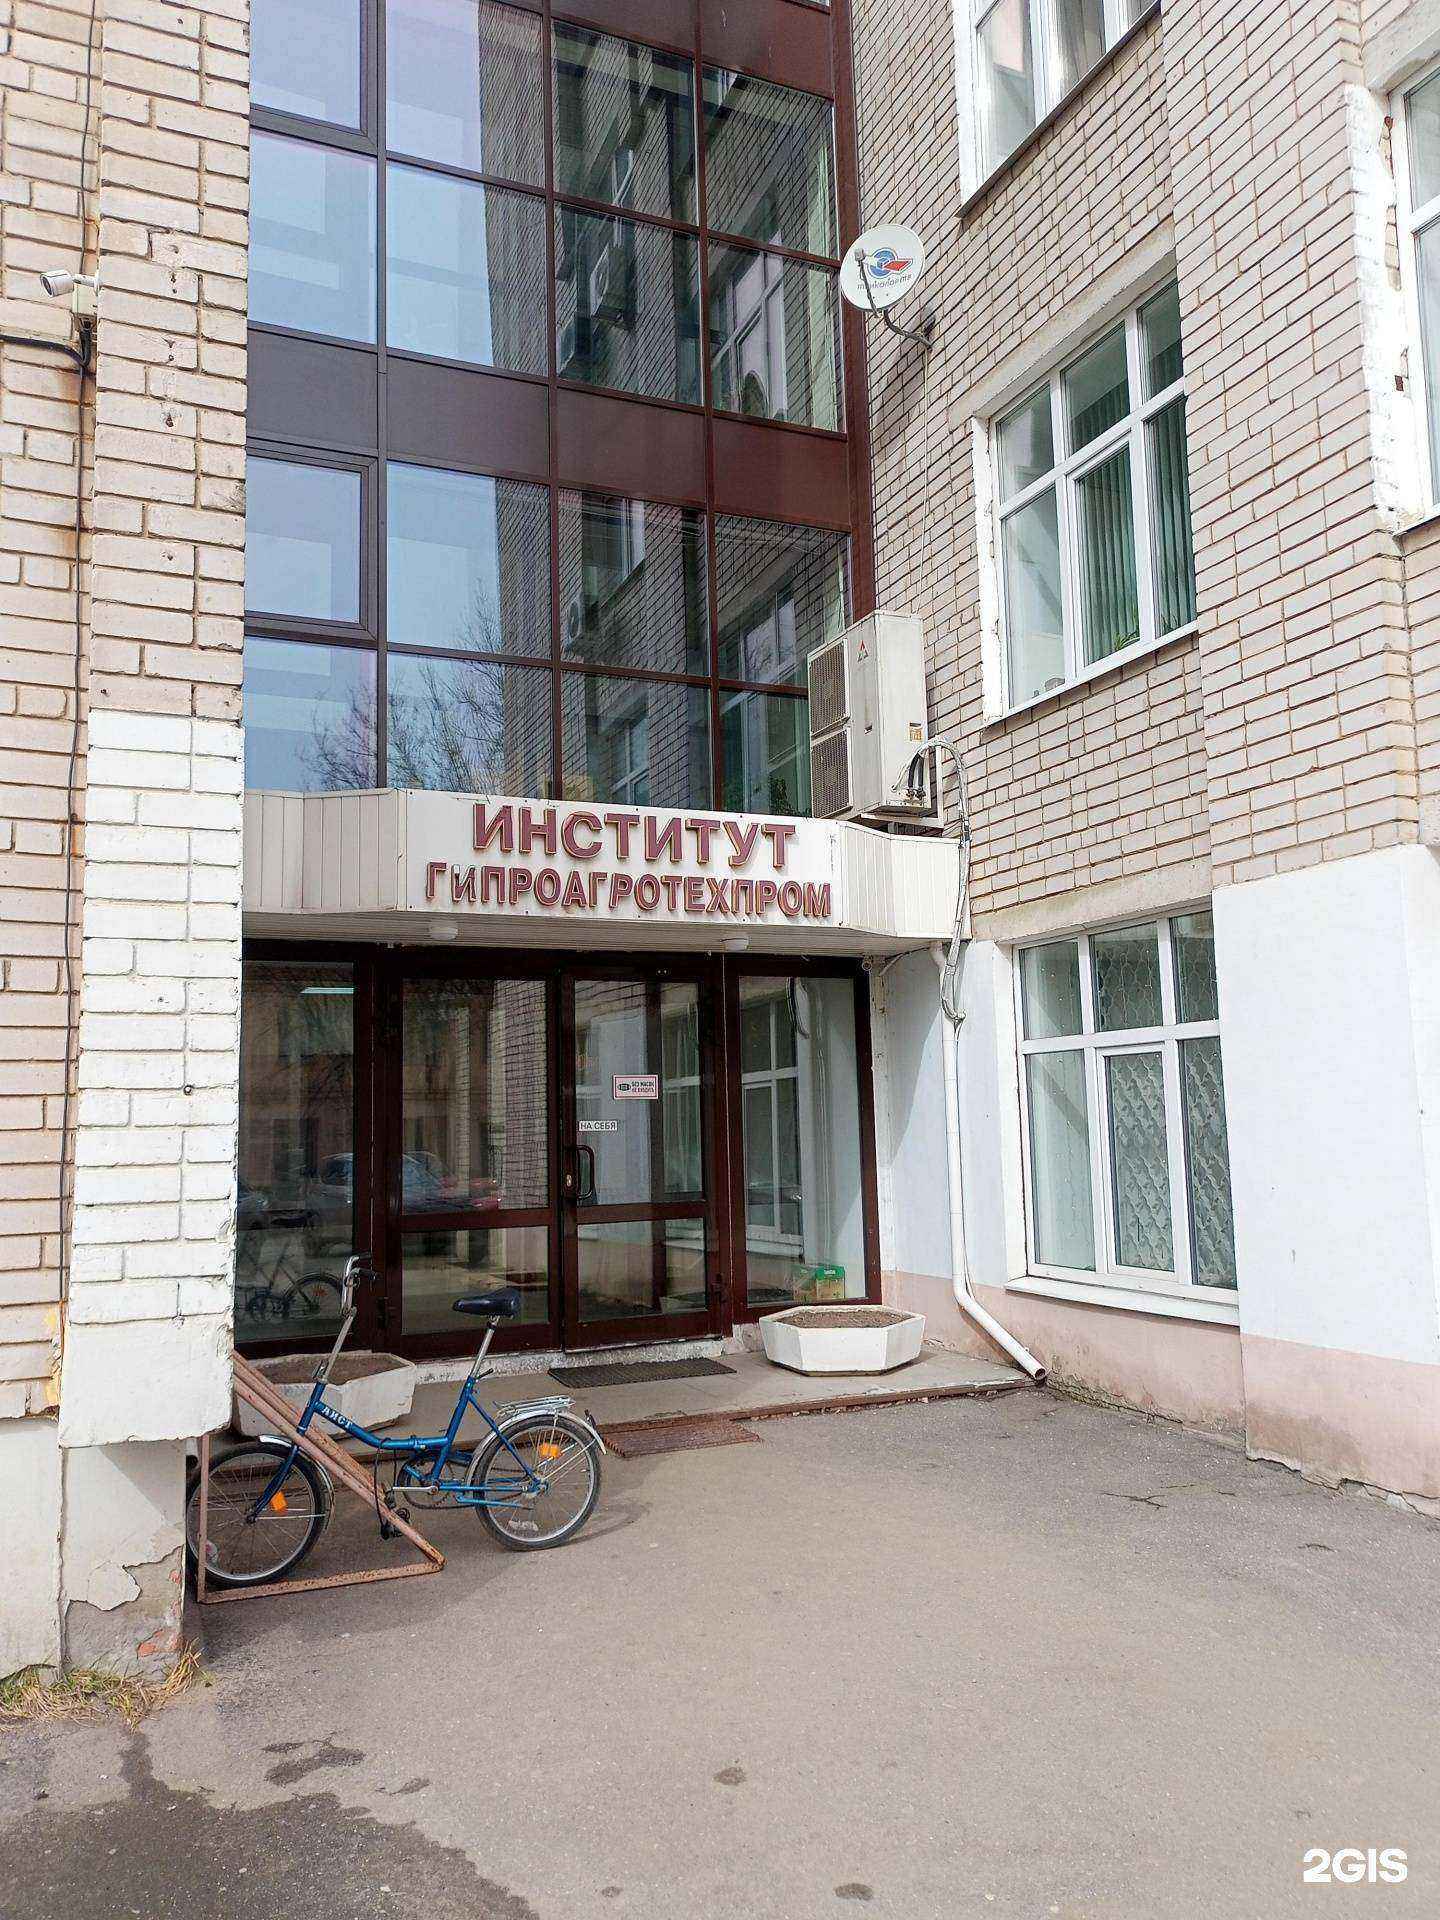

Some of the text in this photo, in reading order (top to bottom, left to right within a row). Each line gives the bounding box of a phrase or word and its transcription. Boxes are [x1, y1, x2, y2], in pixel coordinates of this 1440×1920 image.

[472, 803, 798, 868] ИНСТИТУТ
[426, 861, 832, 918] ГИПРОАГРОТЕХПРОМ
[580, 1122, 616, 1130] НА СЕБЯ
